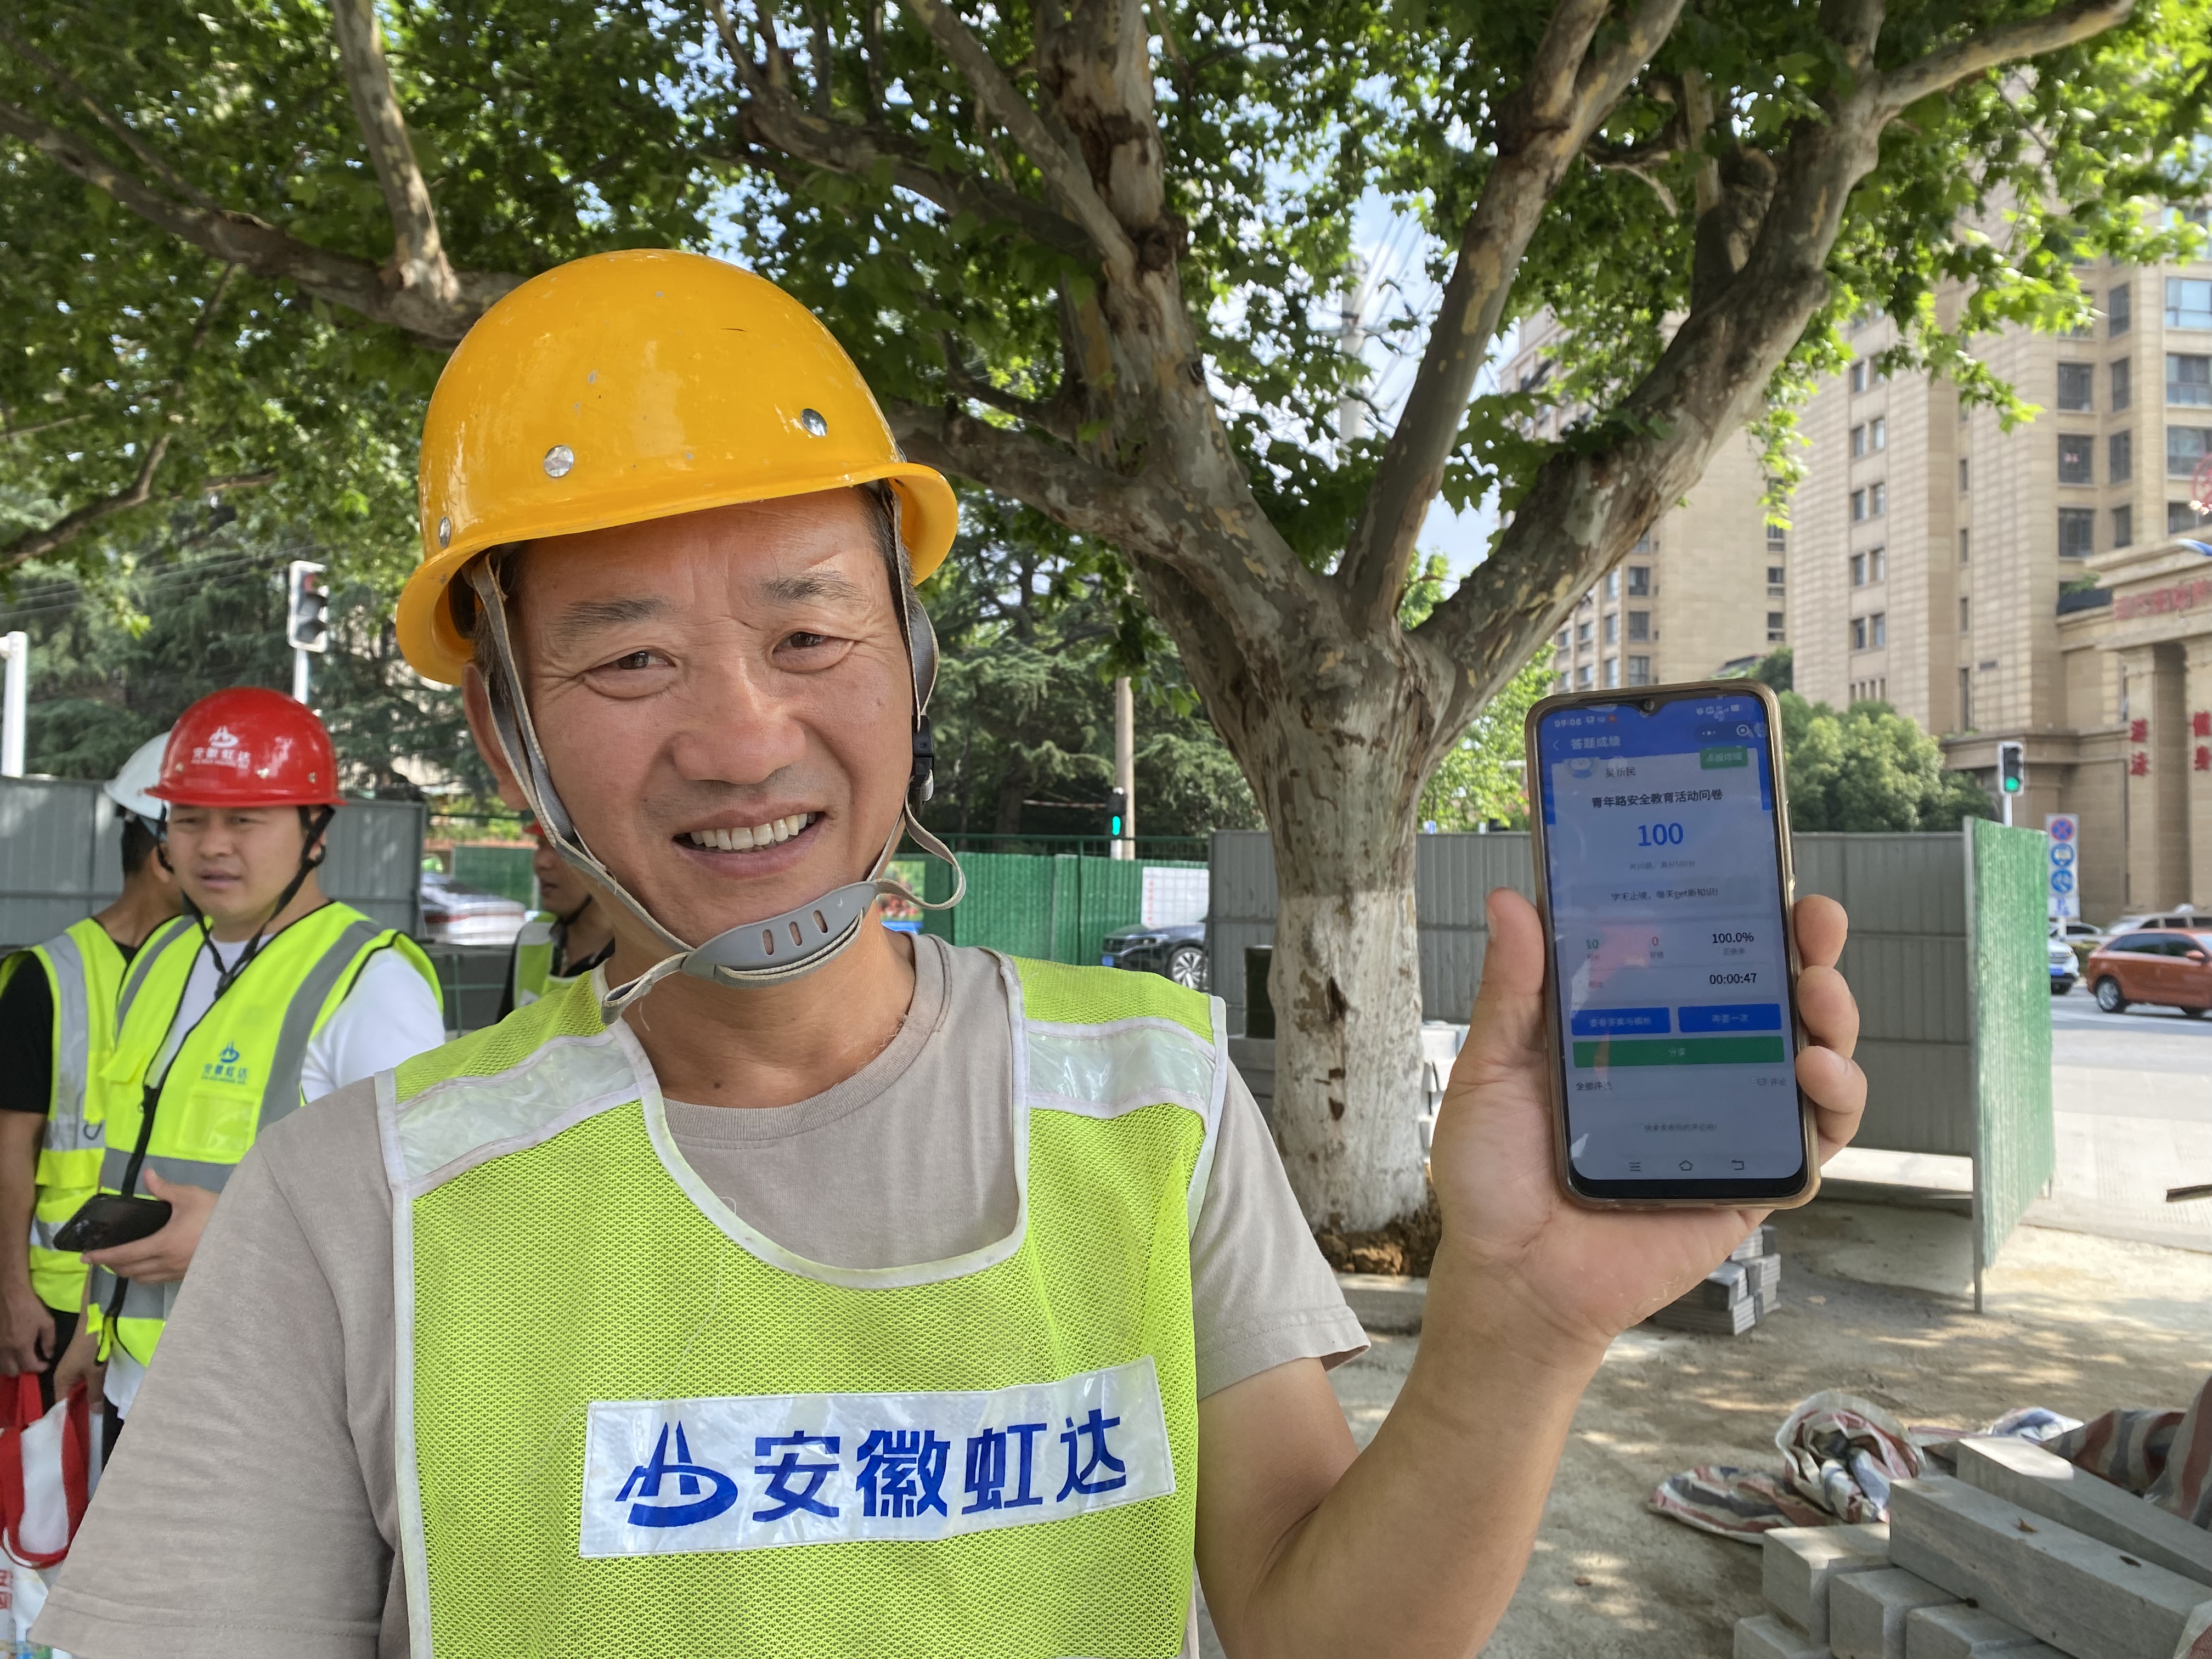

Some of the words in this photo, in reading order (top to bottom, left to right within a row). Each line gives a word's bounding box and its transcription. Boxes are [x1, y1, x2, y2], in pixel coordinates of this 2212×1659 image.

[1571, 735, 1621, 750] 答题成绩
[1592, 789, 1723, 808] 青年路安全教育活动问卷
[1638, 823, 1684, 846] 100
[1652, 936, 1659, 946] 0
[1712, 932, 1754, 944] 100.0%
[1709, 973, 1757, 985] 00:00:47
[753, 1408, 1126, 1522] 安徽虹达
